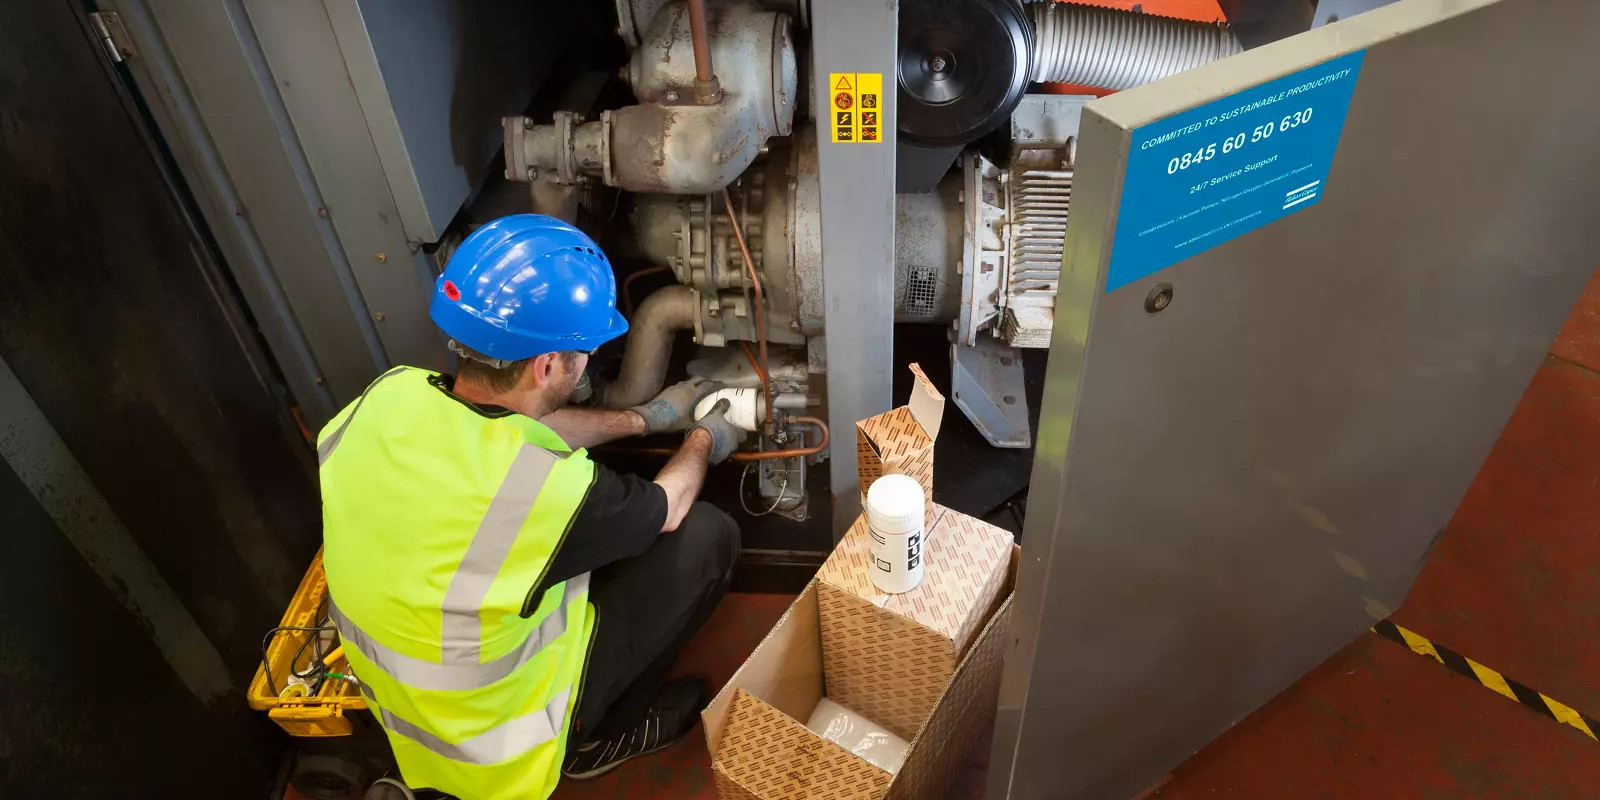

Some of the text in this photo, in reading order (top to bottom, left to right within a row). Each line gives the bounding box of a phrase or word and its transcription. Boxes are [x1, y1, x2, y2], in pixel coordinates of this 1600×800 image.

[1141, 68, 1352, 150] COMMITTED TO SUSTAINABLE PRODUCTIVITY
[1167, 107, 1313, 175] 0845 60 50 630
[1189, 154, 1278, 195] 24/7 Service Support
